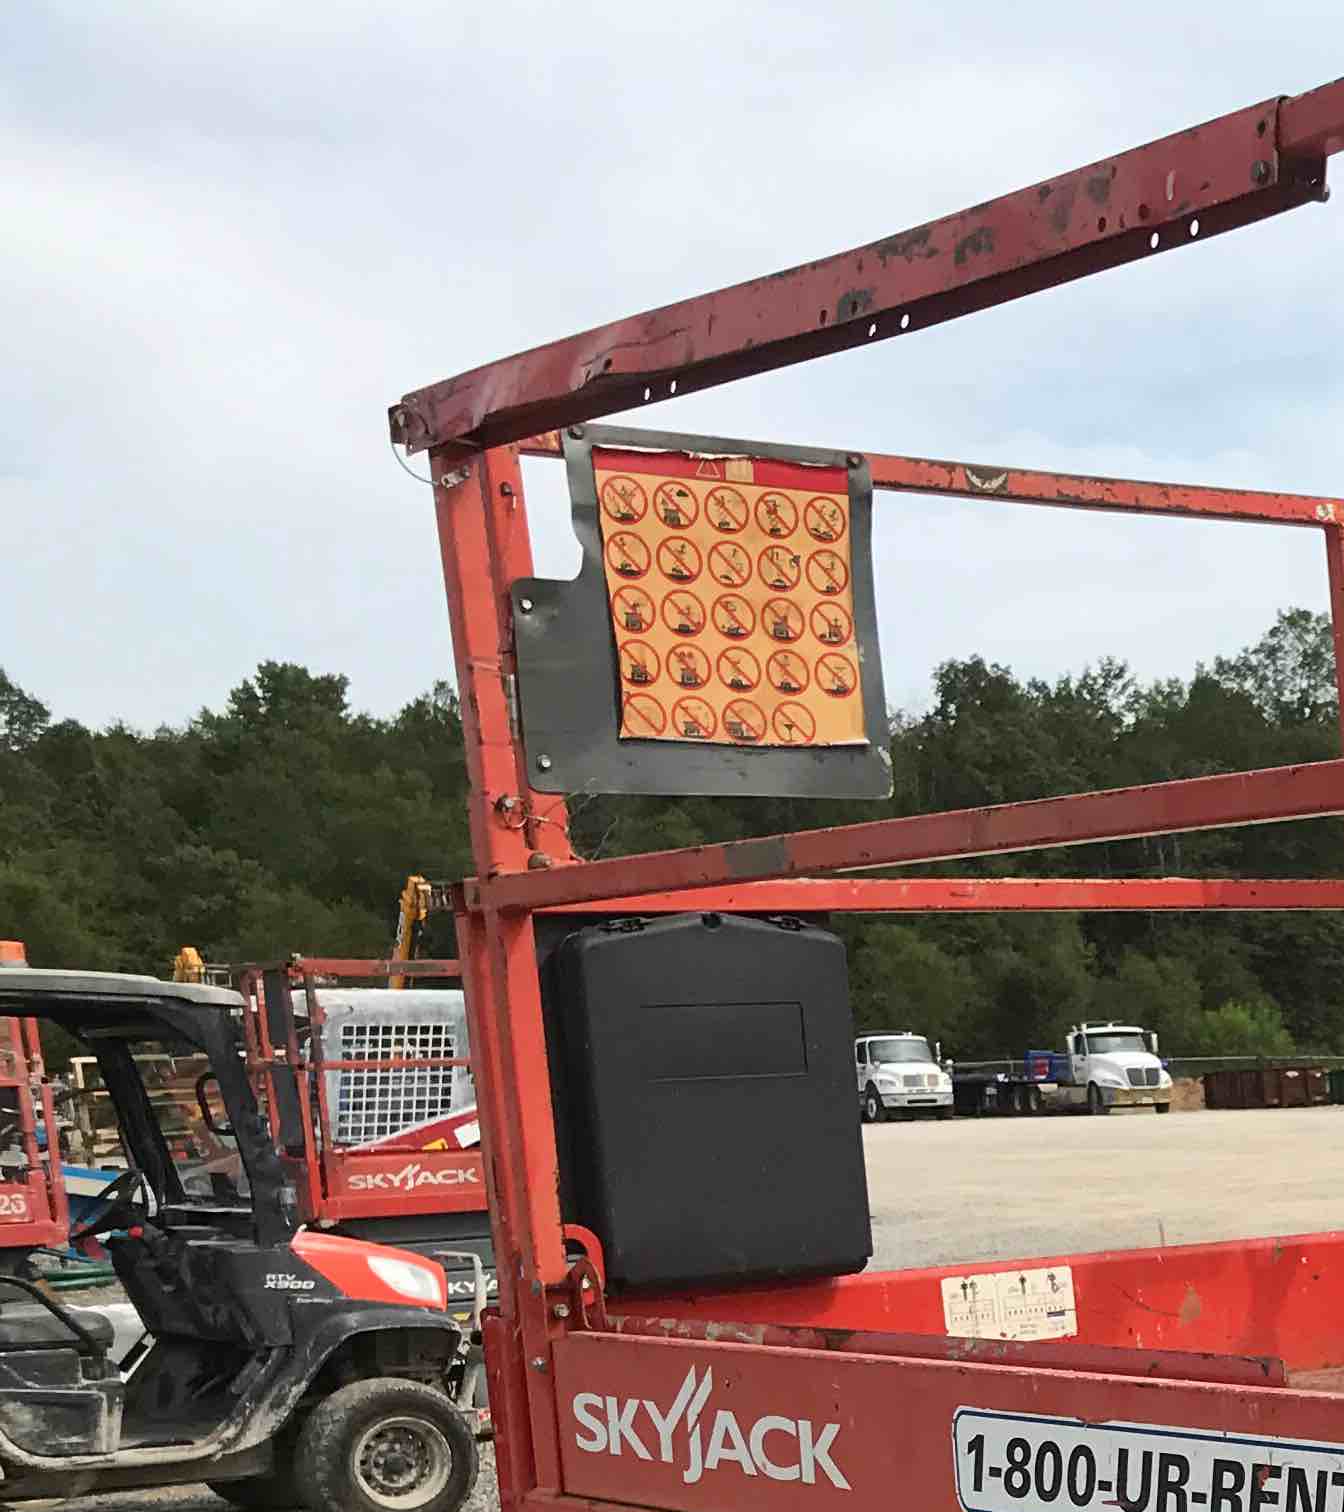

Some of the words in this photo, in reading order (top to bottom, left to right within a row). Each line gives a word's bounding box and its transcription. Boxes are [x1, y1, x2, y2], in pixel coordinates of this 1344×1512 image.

[347, 1163, 480, 1192] SKYJACK
[263, 1279, 316, 1290] X900
[265, 1272, 296, 1281] RTV
[573, 1364, 852, 1491] SKYJACK
